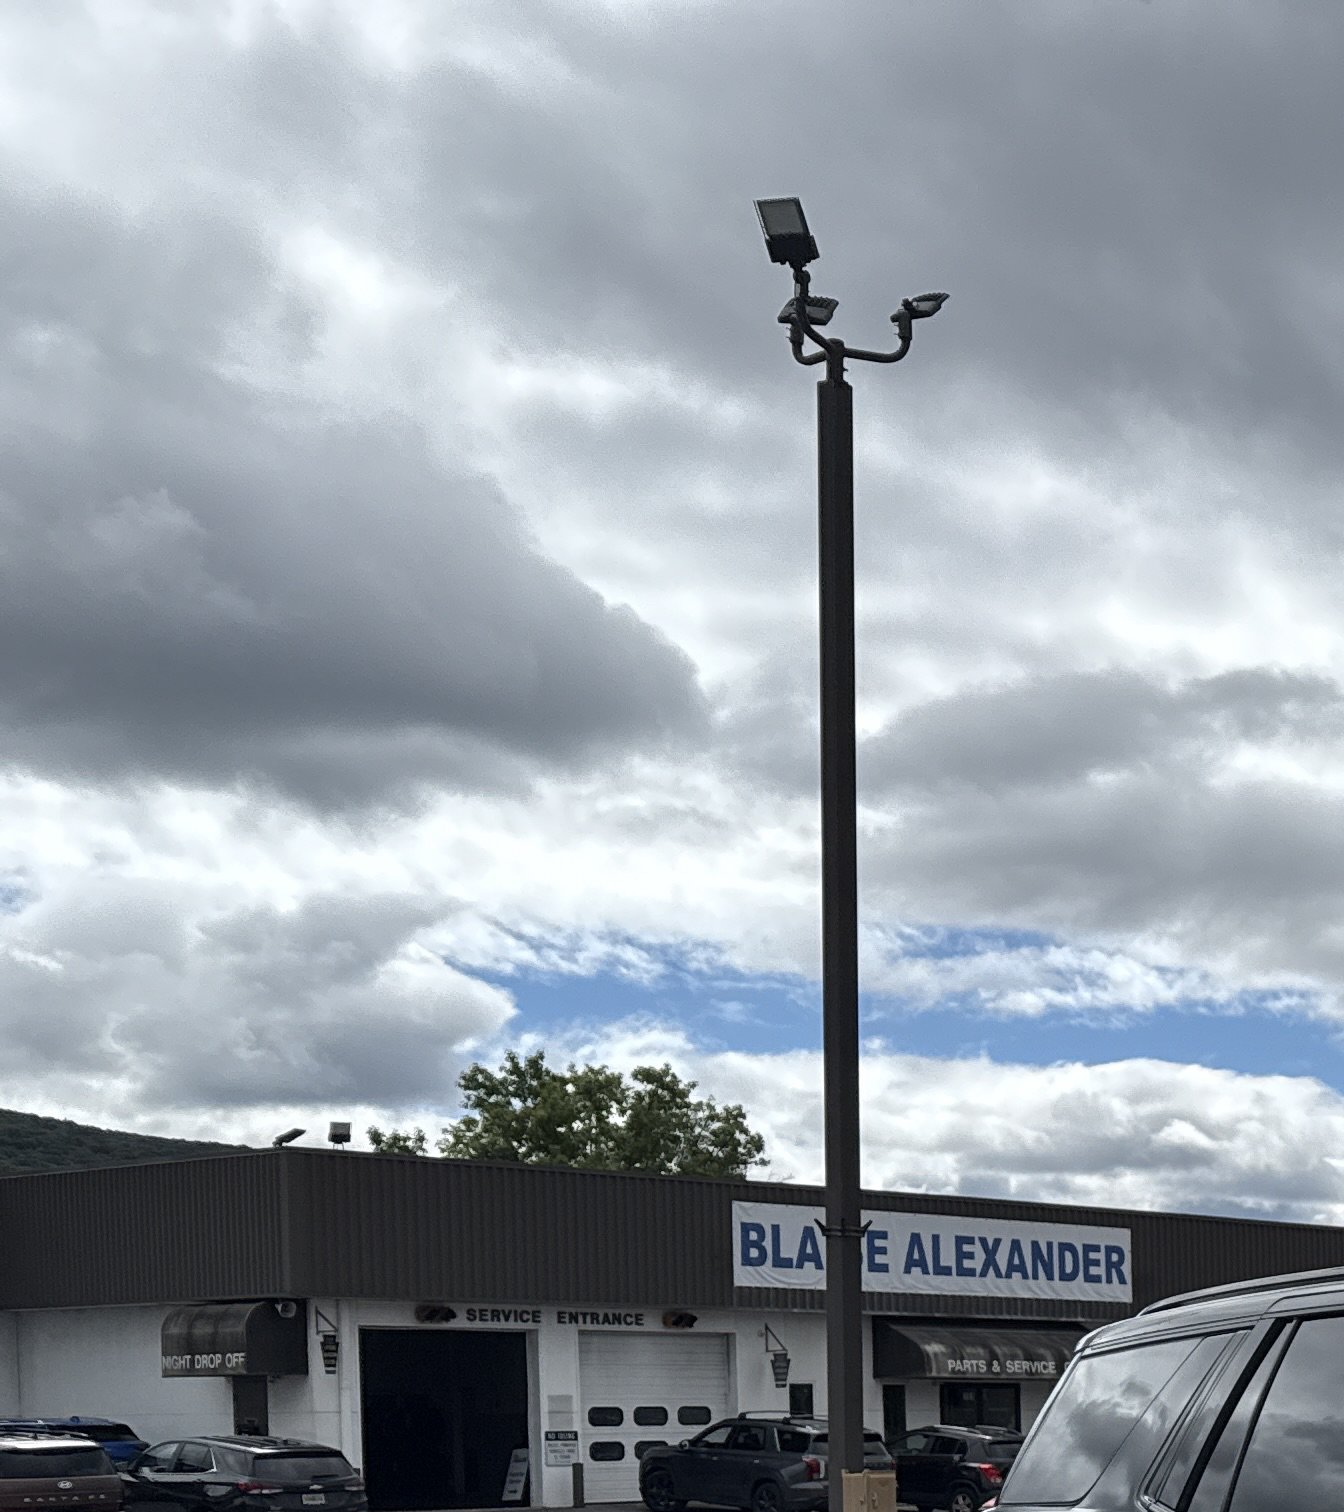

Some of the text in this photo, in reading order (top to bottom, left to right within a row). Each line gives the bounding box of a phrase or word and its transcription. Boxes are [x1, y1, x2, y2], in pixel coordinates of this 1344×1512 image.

[740, 1221, 1128, 1285] BLAE ALEXANDER
[466, 1308, 645, 1326] SERVICE ENTRANCE
[162, 1352, 246, 1369] NIGHT DROP OFF
[948, 1360, 987, 1373] PARTS
[991, 1360, 1001, 1373] &
[1006, 1361, 1057, 1374] SERVICE
